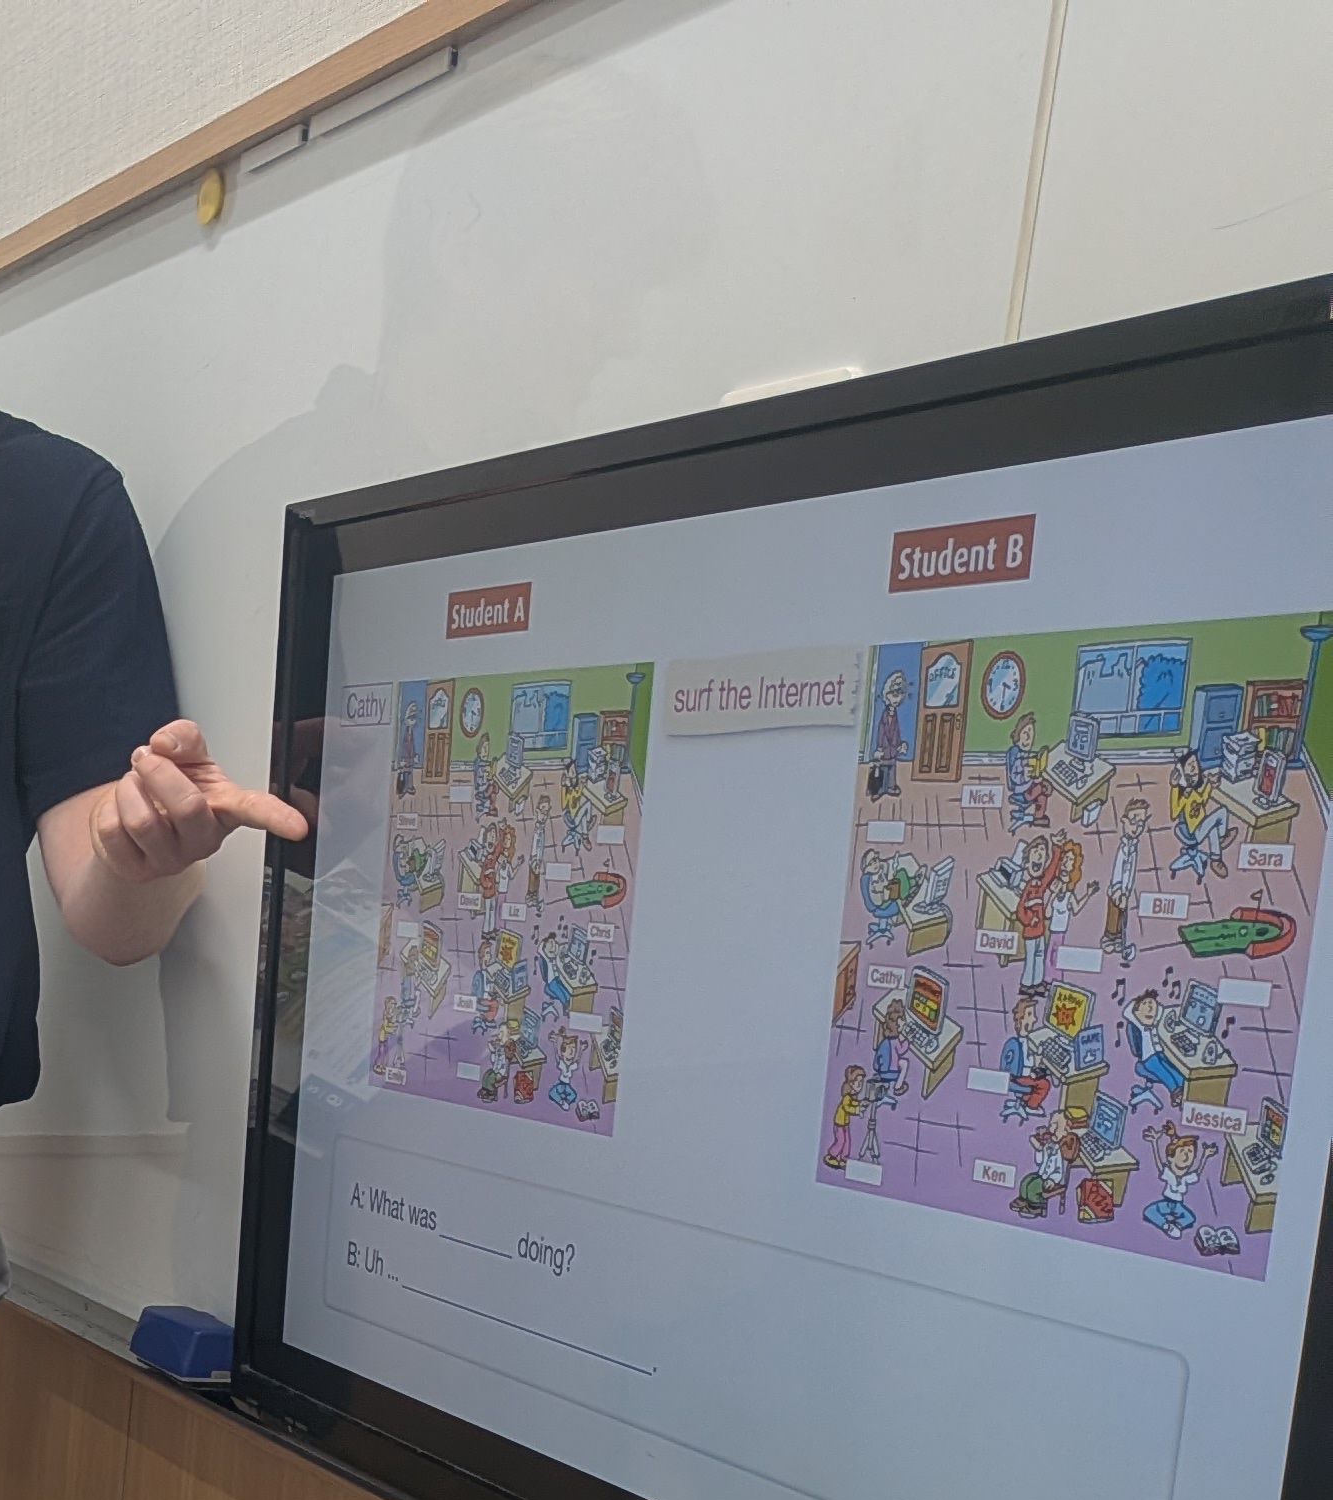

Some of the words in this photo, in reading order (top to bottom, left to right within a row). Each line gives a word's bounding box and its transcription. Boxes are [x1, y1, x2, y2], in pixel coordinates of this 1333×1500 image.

[898, 536, 997, 580] Student
[1006, 533, 1023, 568] B
[451, 592, 511, 630] Student
[513, 600, 526, 622] A
[673, 682, 715, 714] surf
[718, 678, 753, 711] the
[757, 672, 844, 708] Internet
[346, 691, 386, 723] Cathy
[969, 788, 996, 805] Nick
[1247, 848, 1283, 867] Sara
[1151, 898, 1176, 914] Bill
[979, 934, 1015, 951] David
[870, 968, 903, 989] Cathy
[1184, 1108, 1244, 1132] Jessica
[982, 1165, 1007, 1183] Ken
[350, 1183, 365, 1209] A:
[369, 1186, 406, 1223] What
[407, 1204, 437, 1231] was
[517, 1235, 576, 1277] doing?
[346, 1241, 361, 1268] B:
[364, 1246, 384, 1277] Uh
